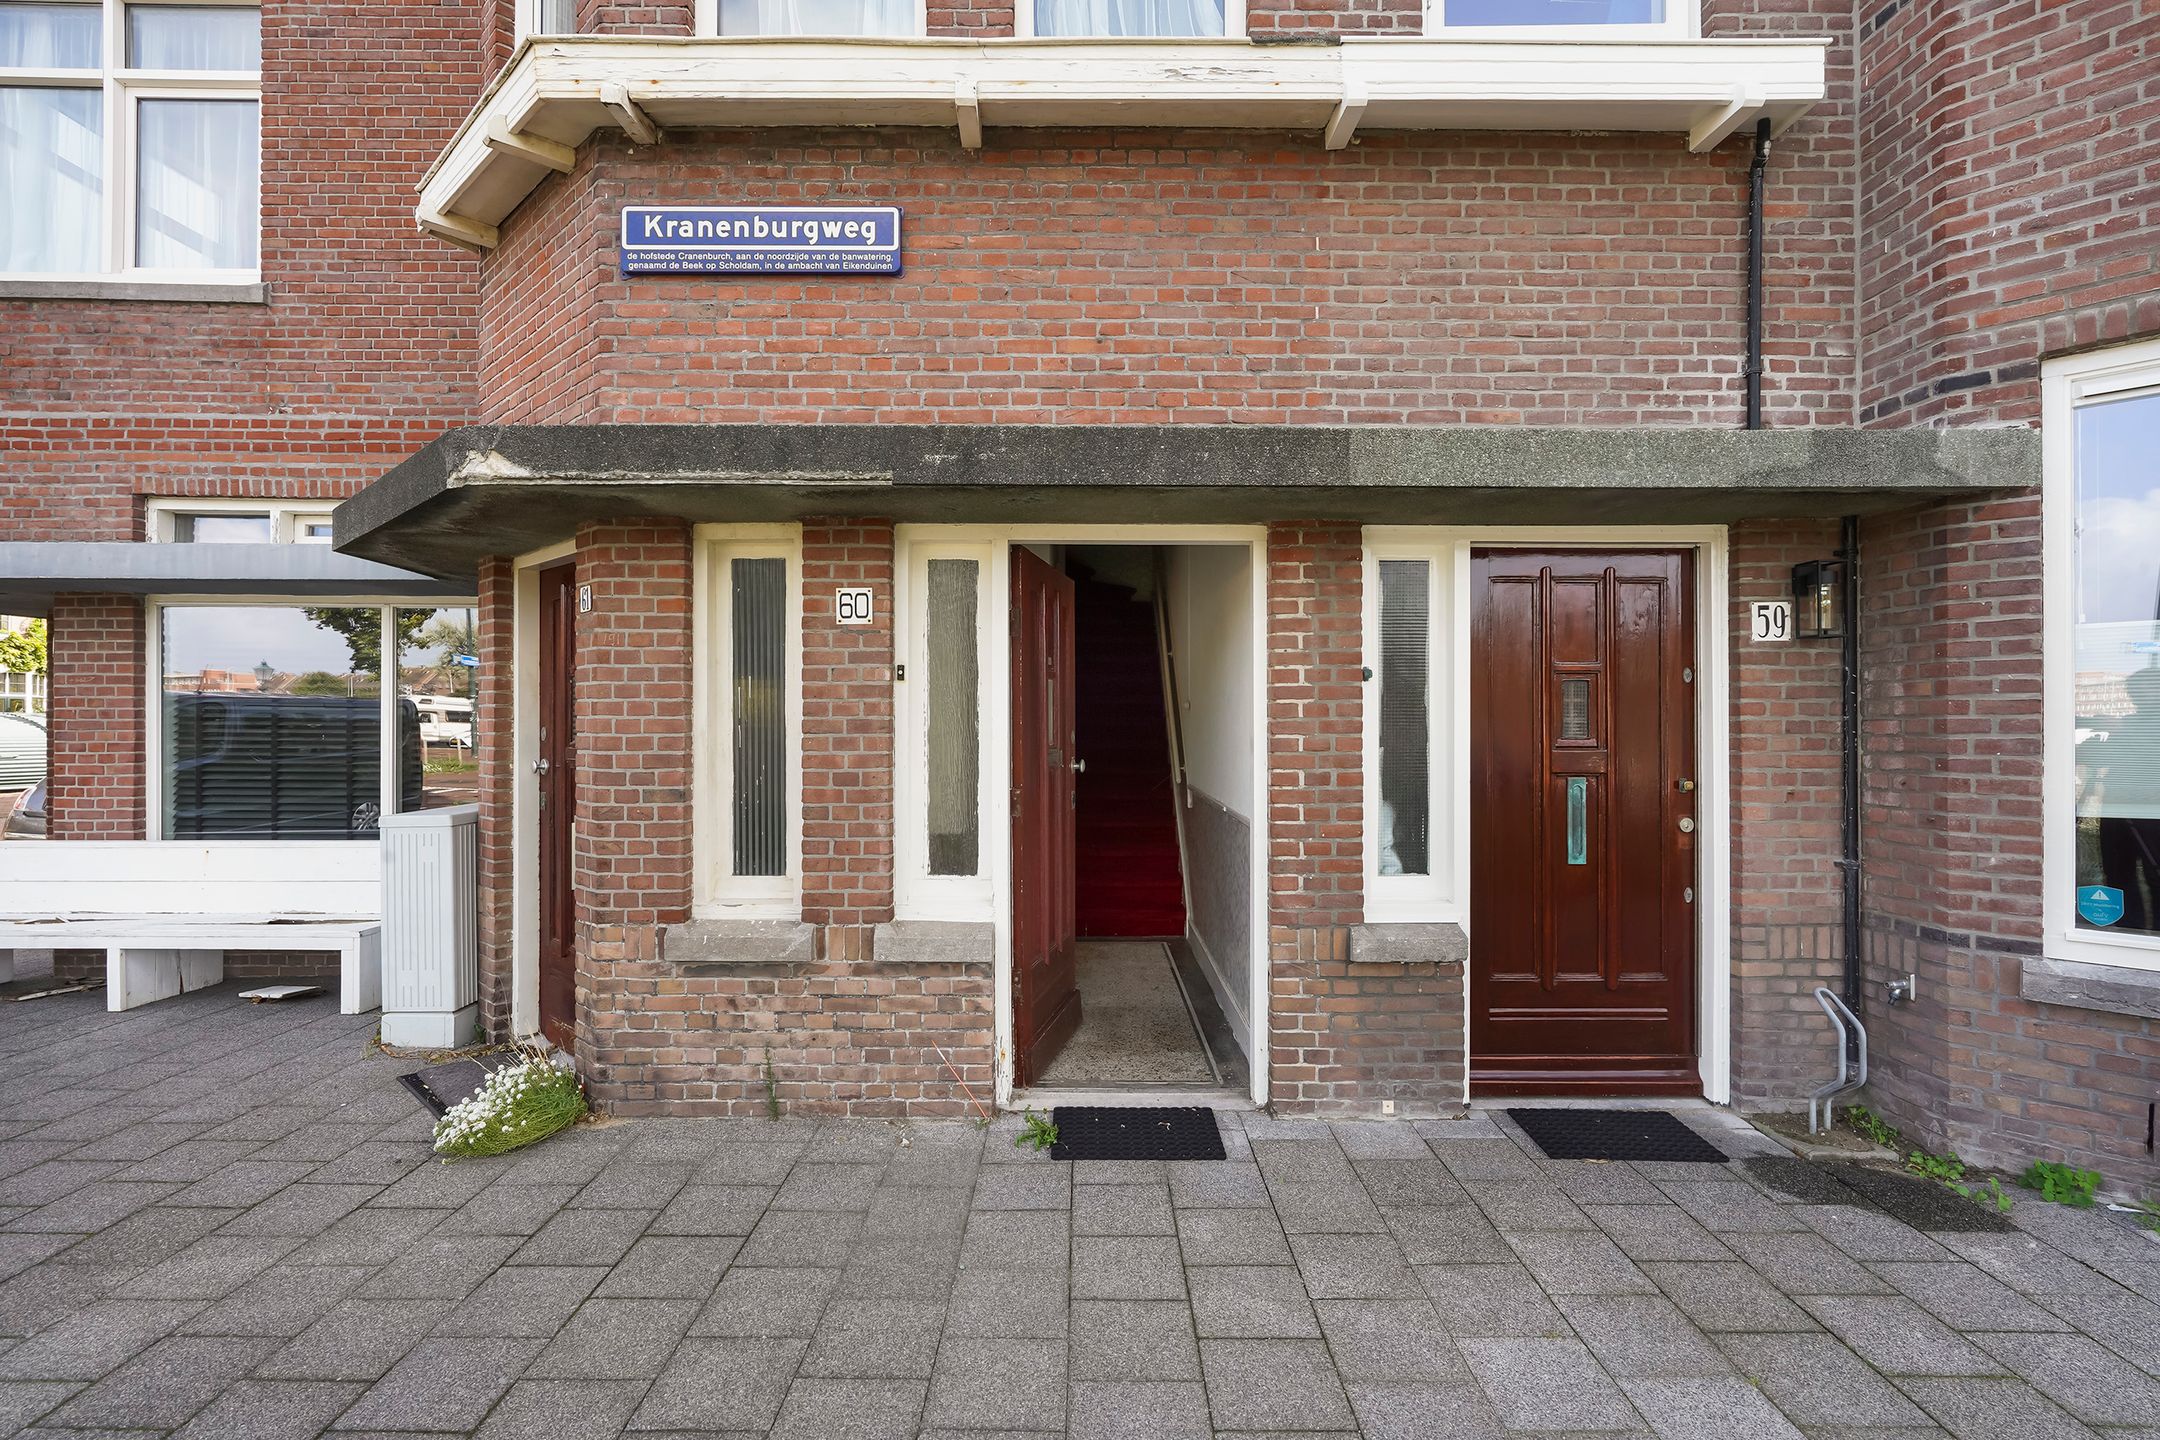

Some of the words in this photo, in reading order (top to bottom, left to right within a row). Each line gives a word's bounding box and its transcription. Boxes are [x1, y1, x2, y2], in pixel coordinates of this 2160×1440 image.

[644, 215, 876, 245] Kranenburgweg
[629, 262, 666, 270] genaamd
[719, 262, 762, 270] Scholdam,
[843, 262, 892, 270] Eikenduinen
[640, 252, 676, 260] hofstede
[678, 252, 732, 261] Cranenburch,
[767, 253, 809, 262] noordzijde
[842, 253, 894, 262] banwatering,
[582, 587, 589, 610] 61
[839, 593, 869, 618] 60
[1758, 605, 1786, 638] 59
